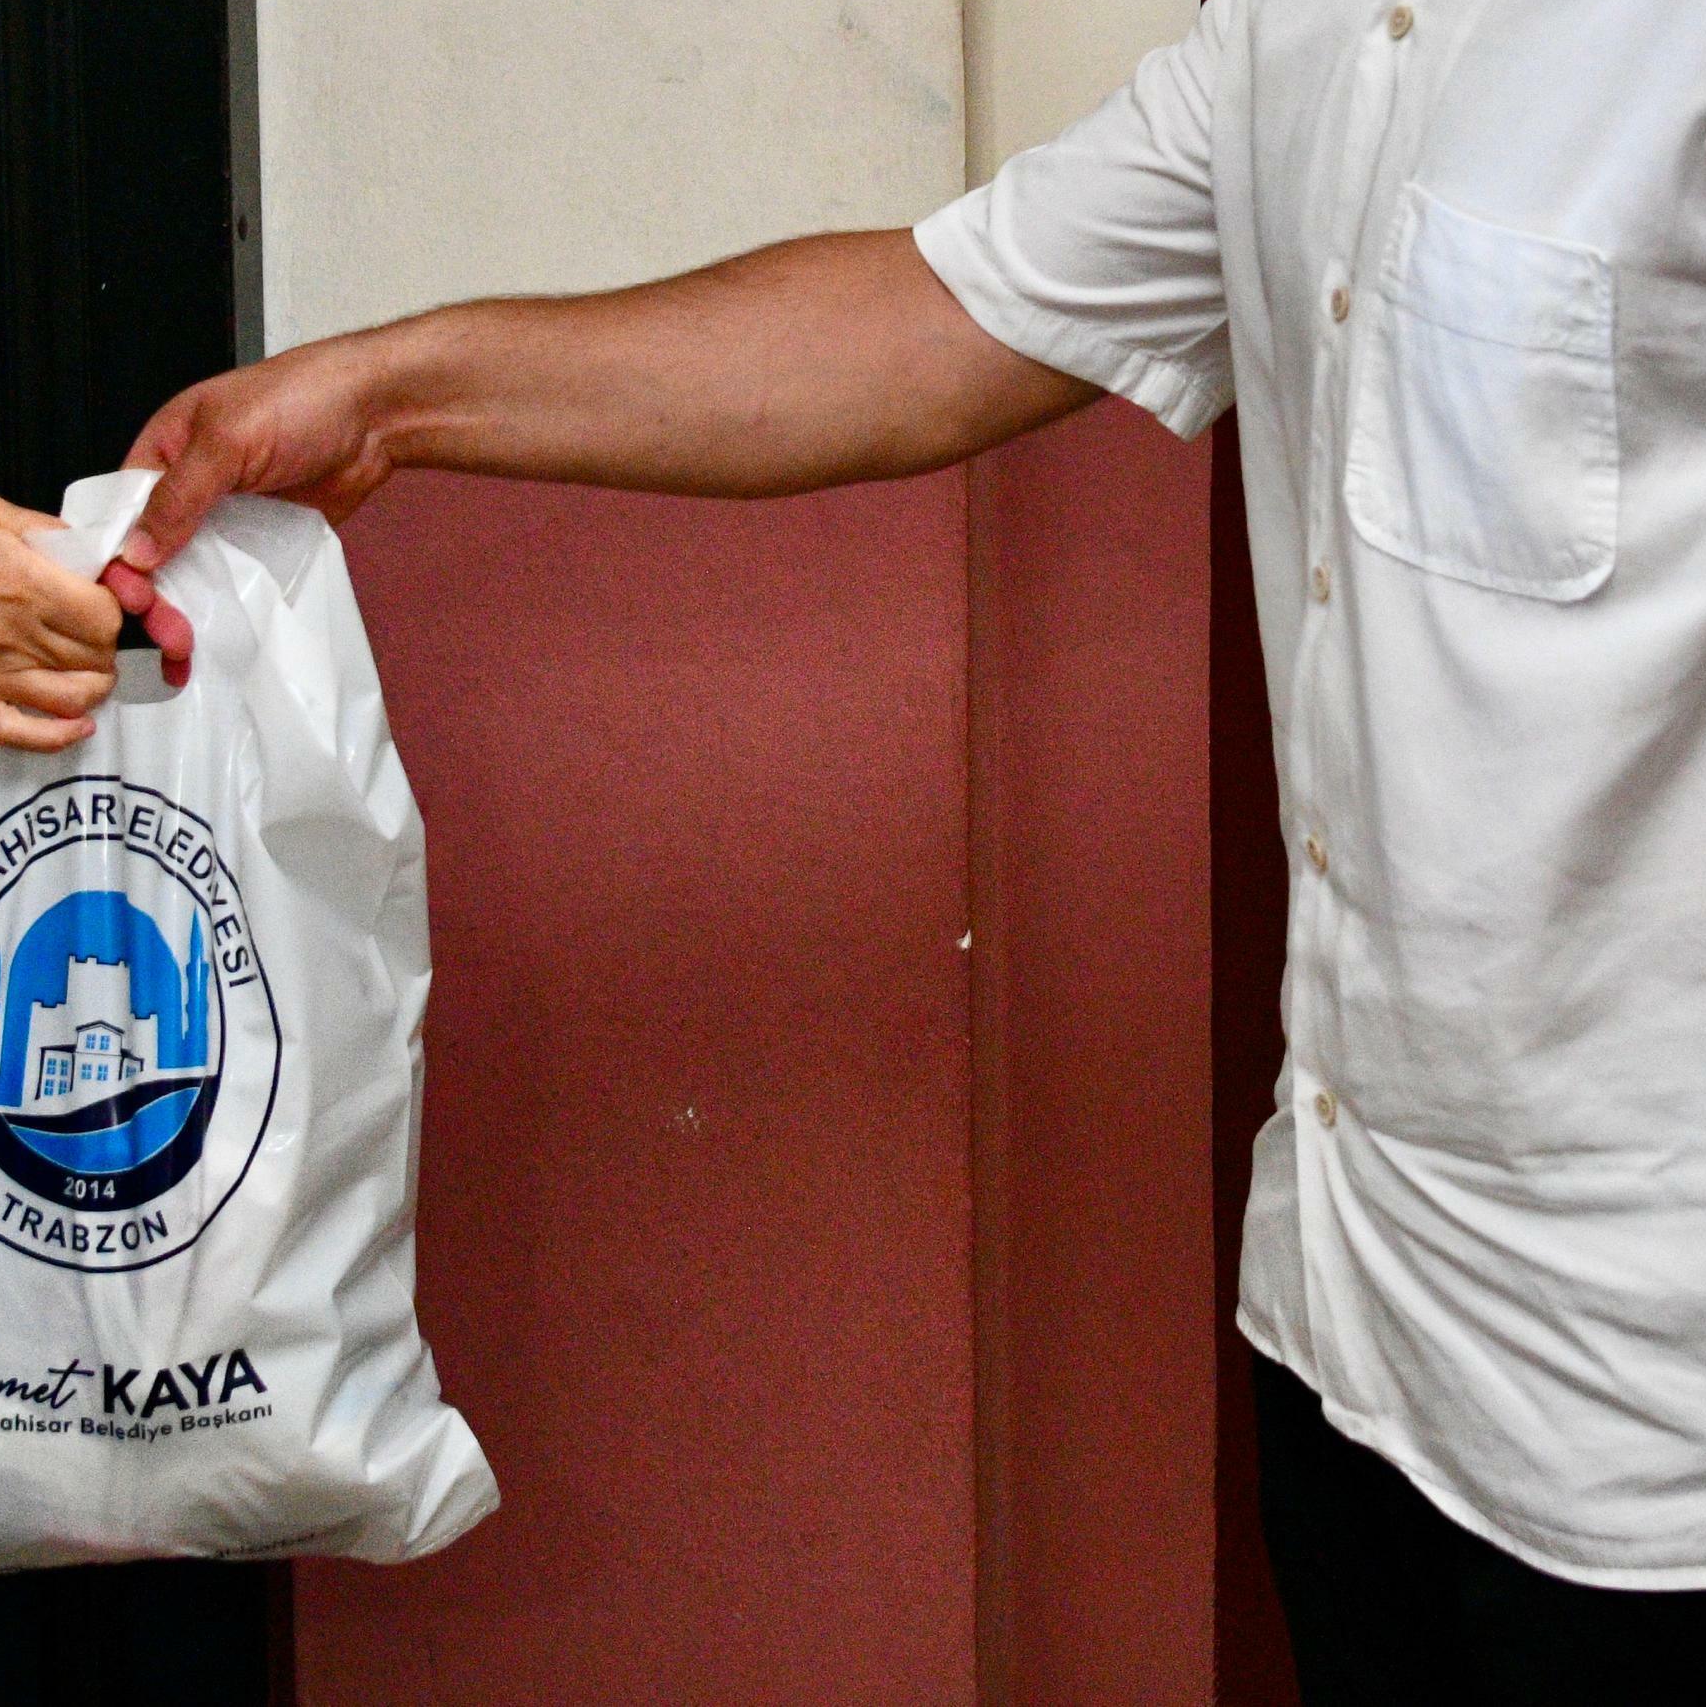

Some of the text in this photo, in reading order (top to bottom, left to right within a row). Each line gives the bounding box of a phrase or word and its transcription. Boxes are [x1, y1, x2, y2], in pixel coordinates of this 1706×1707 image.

[64, 1175, 117, 1200] 2014
[1, 1192, 169, 1254] TRABZON
[103, 1347, 268, 1419] KAYA
[80, 1416, 173, 1444] Belediye
[180, 1403, 273, 1433] Başkanı
